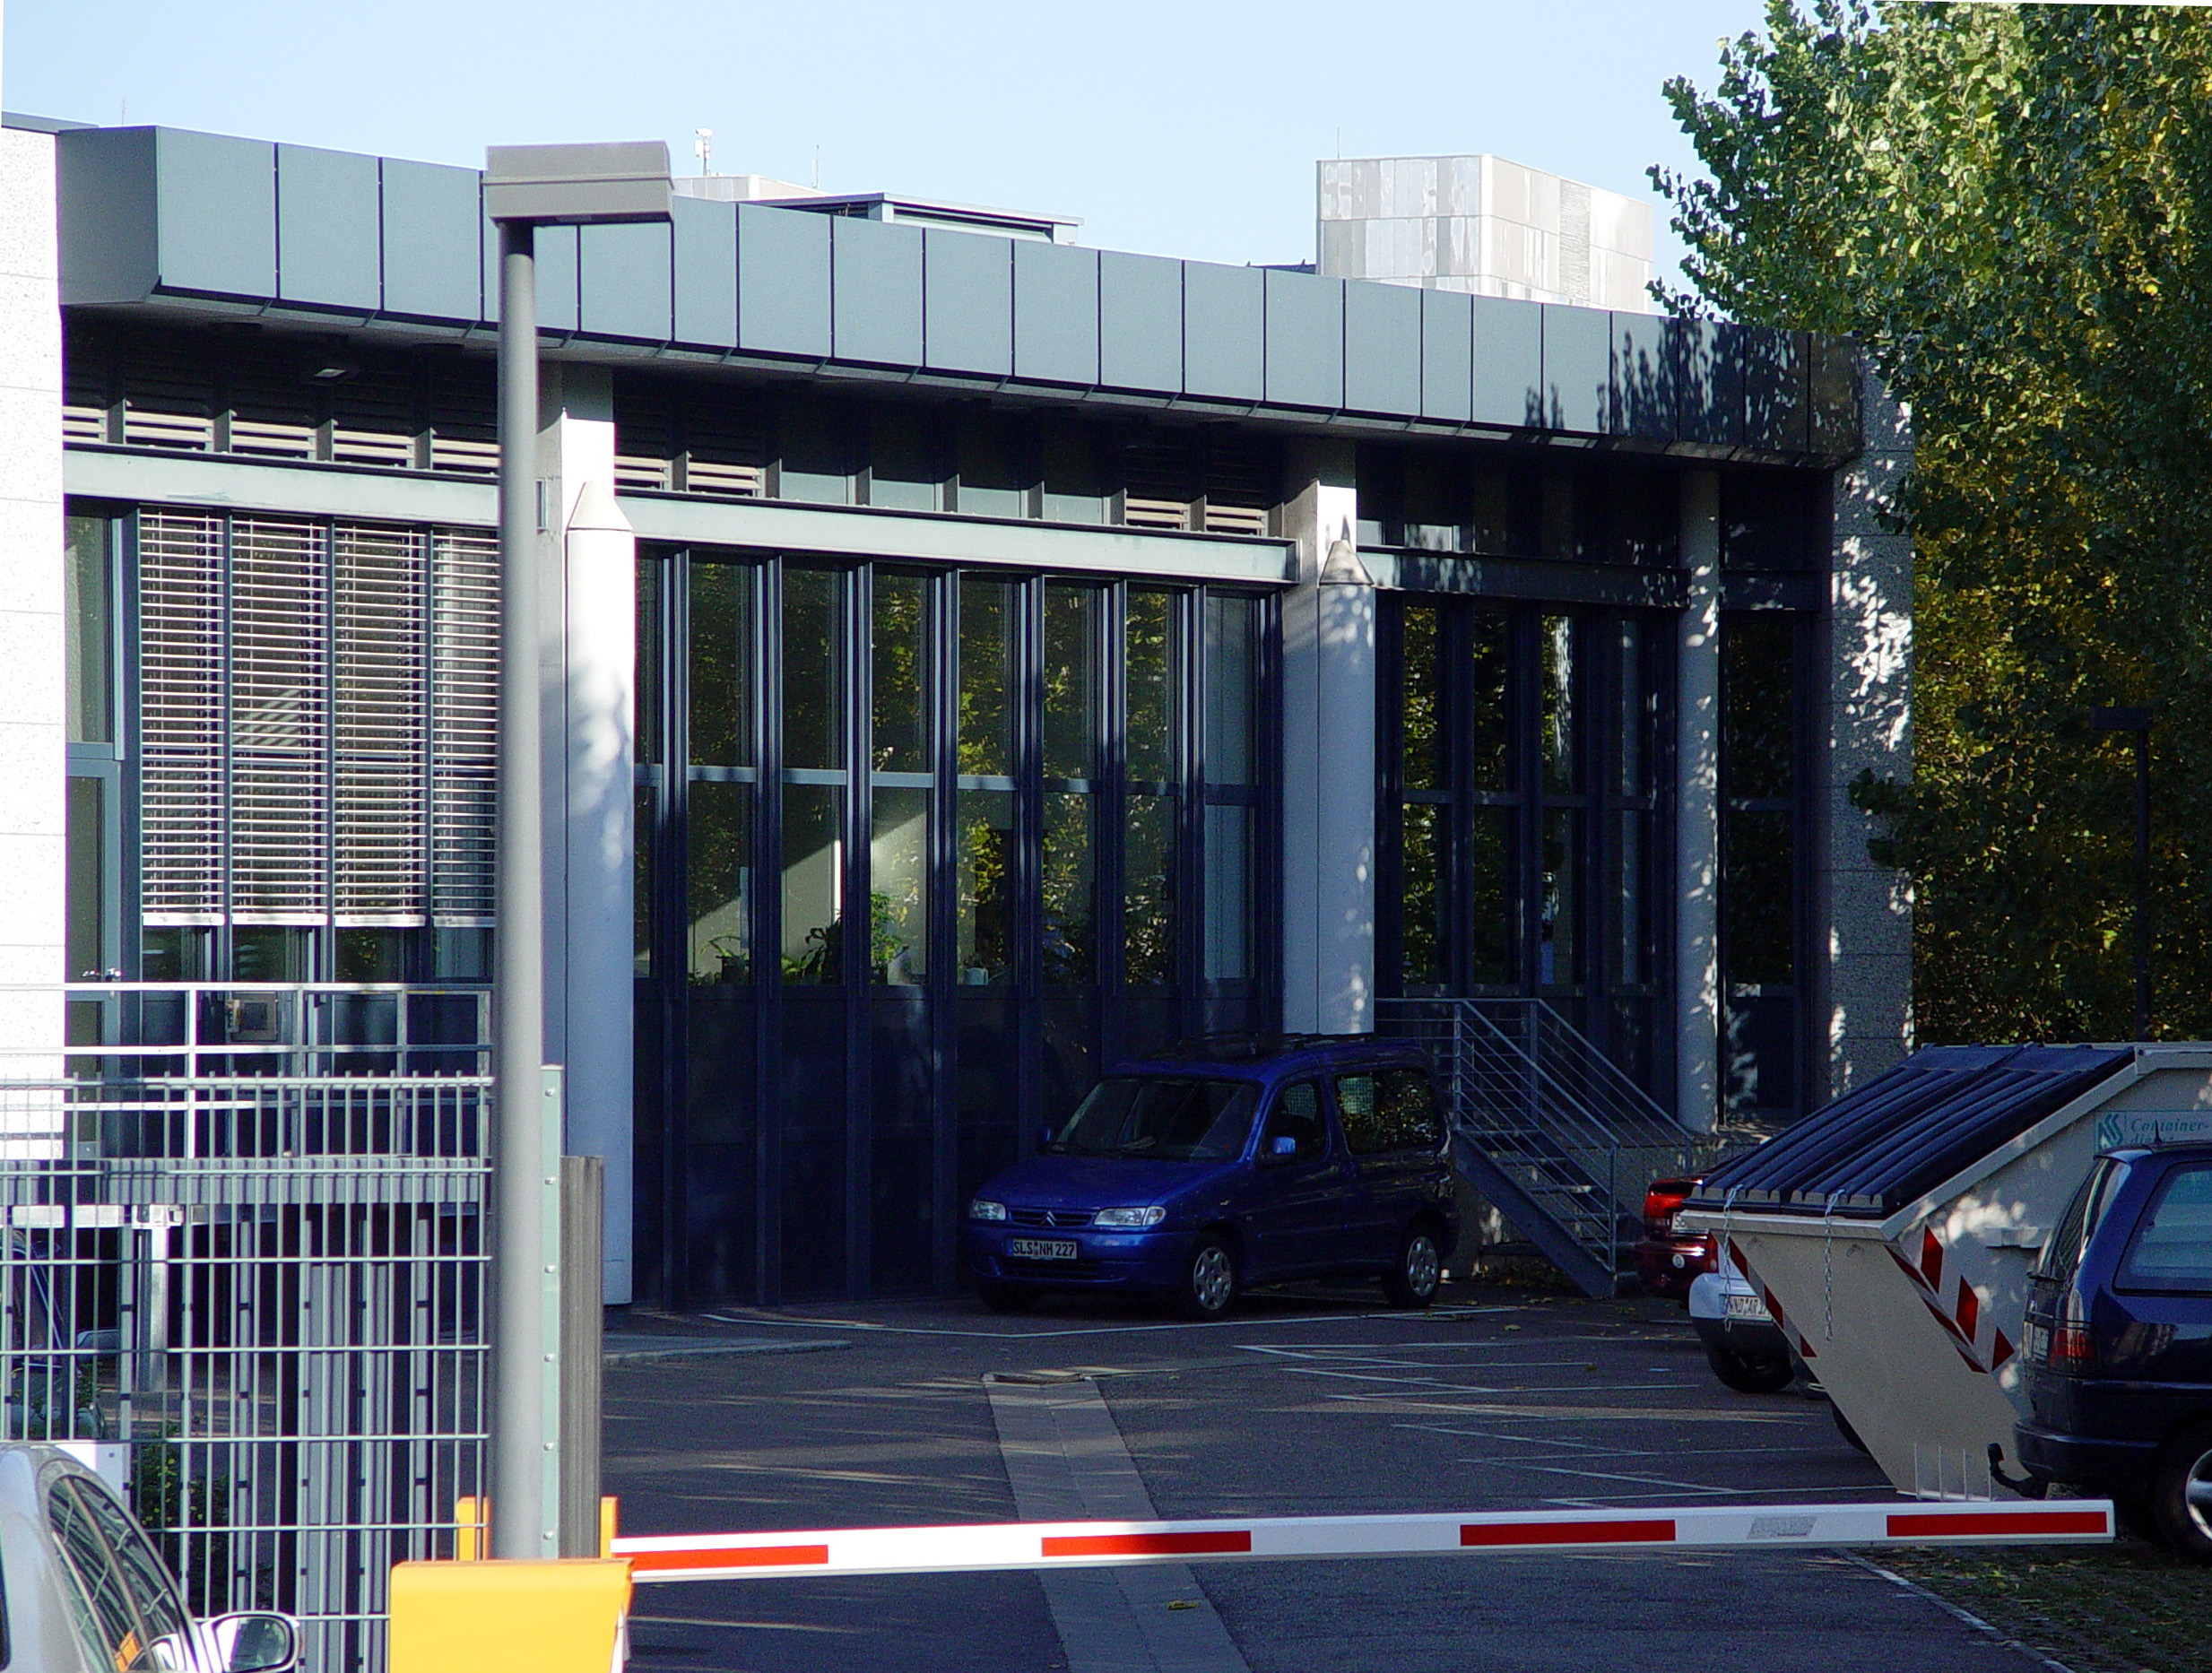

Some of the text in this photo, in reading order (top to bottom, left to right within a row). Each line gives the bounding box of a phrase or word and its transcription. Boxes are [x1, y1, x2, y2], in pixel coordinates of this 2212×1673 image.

[1013, 1241, 1075, 1257] SLS NH 227
